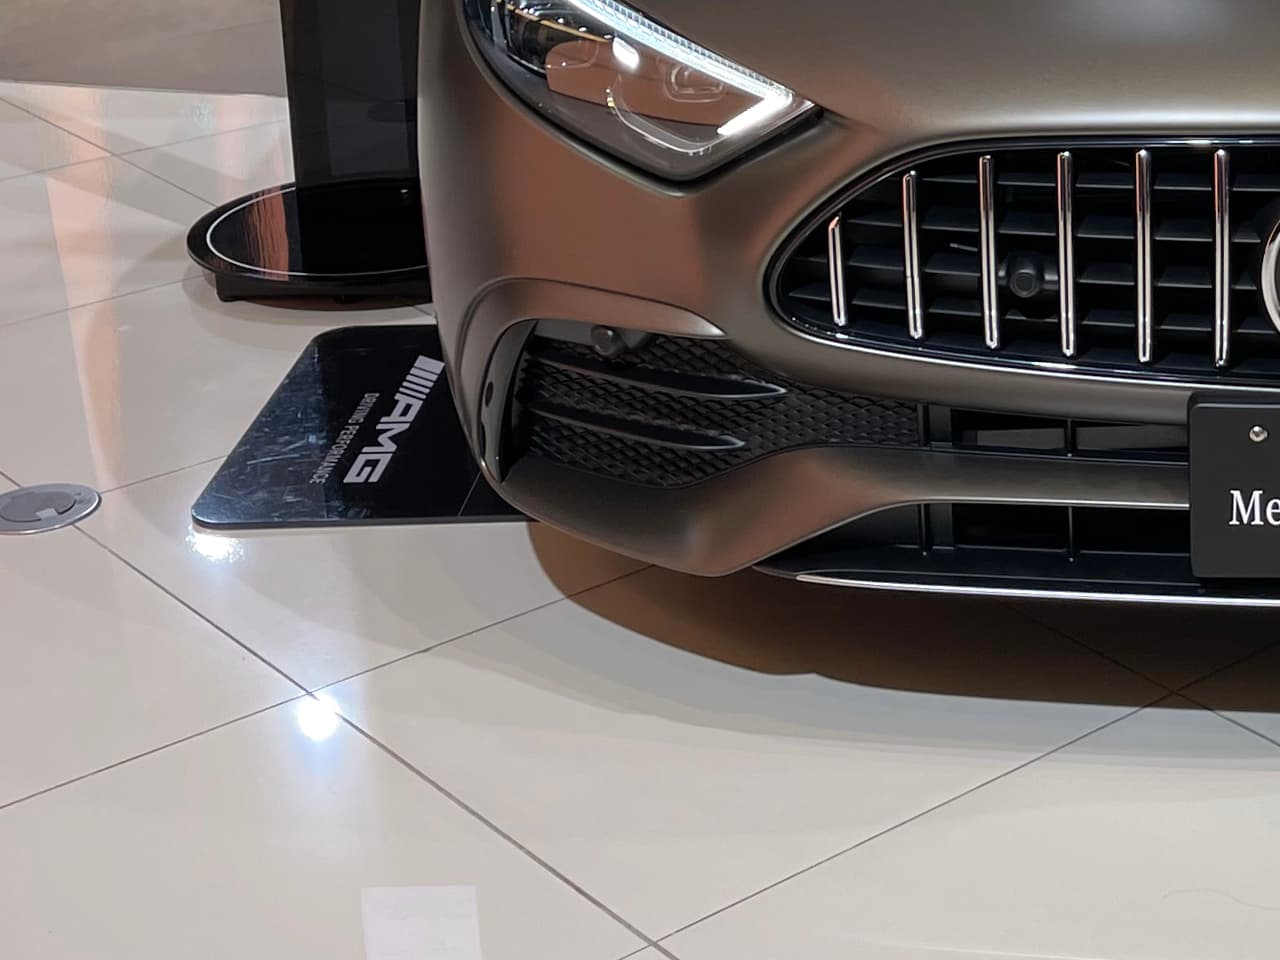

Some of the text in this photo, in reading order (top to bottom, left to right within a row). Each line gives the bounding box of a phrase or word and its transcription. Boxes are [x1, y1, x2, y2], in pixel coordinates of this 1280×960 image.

[309, 392, 380, 484] DRIVING PERFORMANCE
[343, 393, 424, 483] AMG
